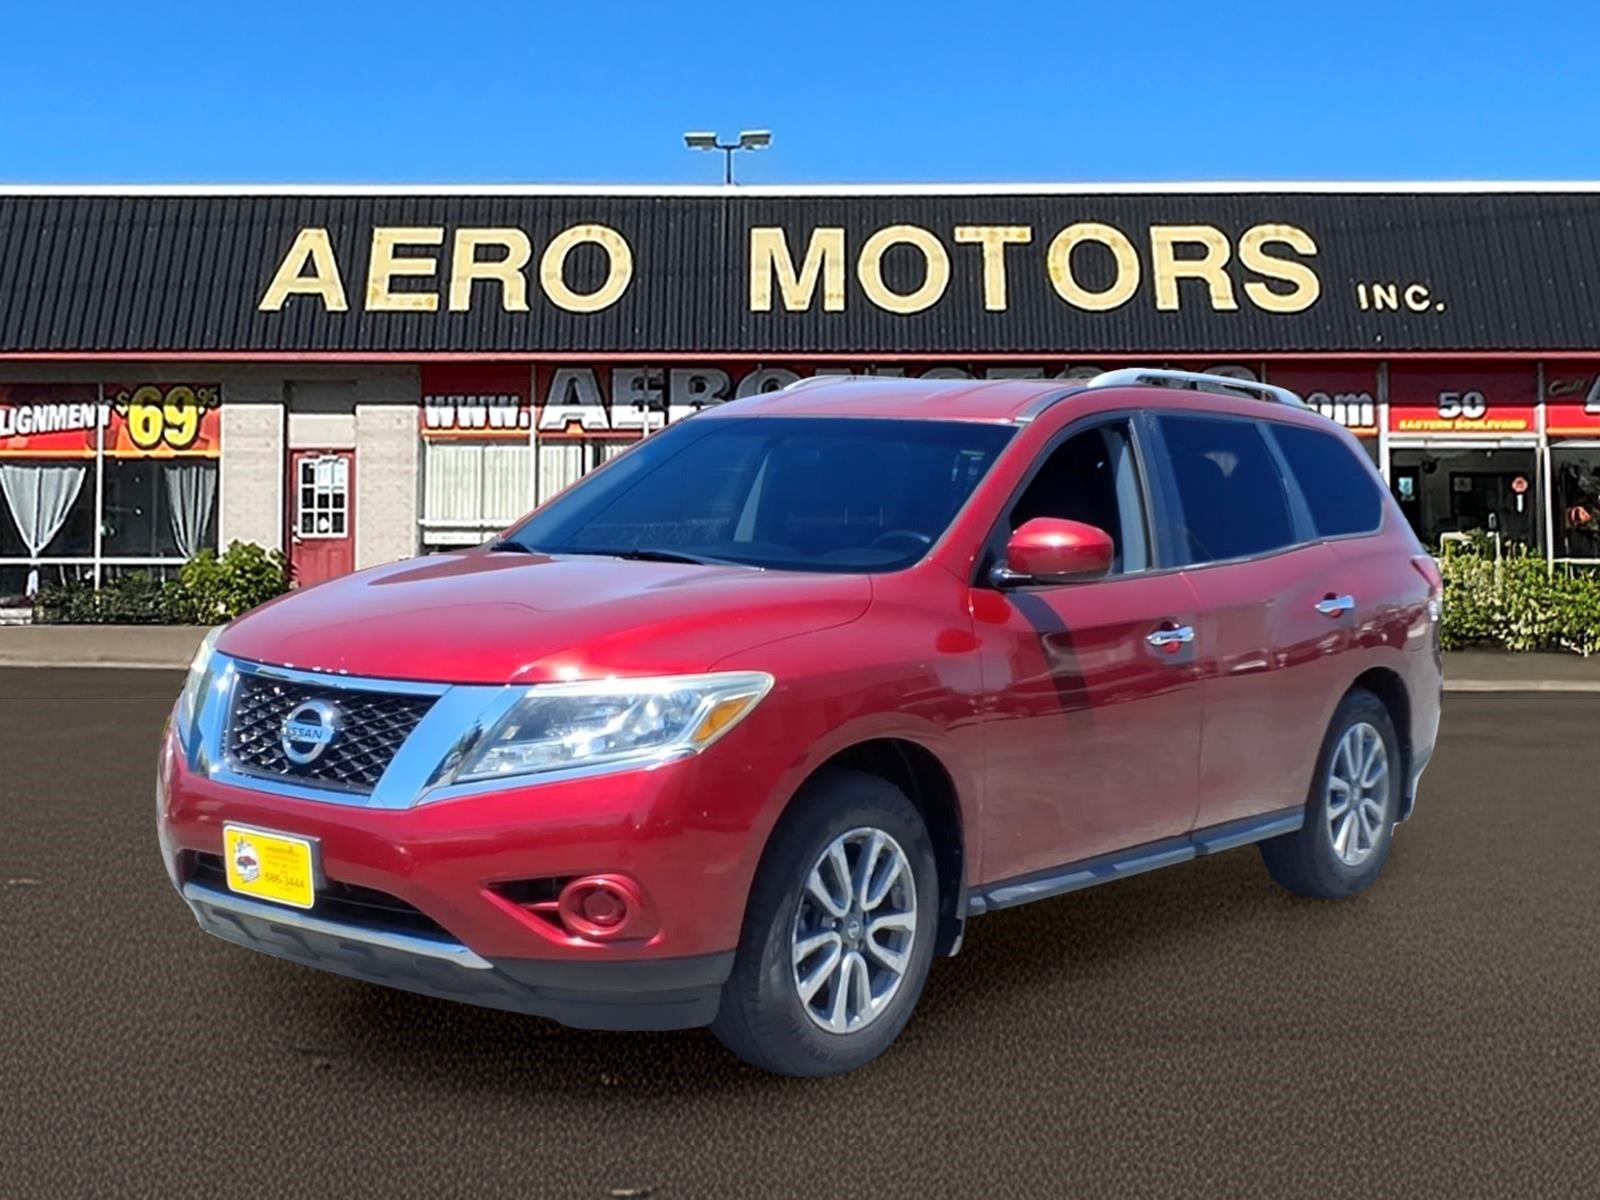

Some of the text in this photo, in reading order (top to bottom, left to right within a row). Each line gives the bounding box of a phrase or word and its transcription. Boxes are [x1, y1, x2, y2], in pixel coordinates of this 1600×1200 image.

[258, 222, 1446, 315] AERO MOTORS INC.
[1549, 379, 1587, 396] Call
[0, 401, 110, 436] LIGNMENT
[1438, 391, 1486, 419] 50
[1399, 420, 1527, 430] EASTERN BOULEVARD
